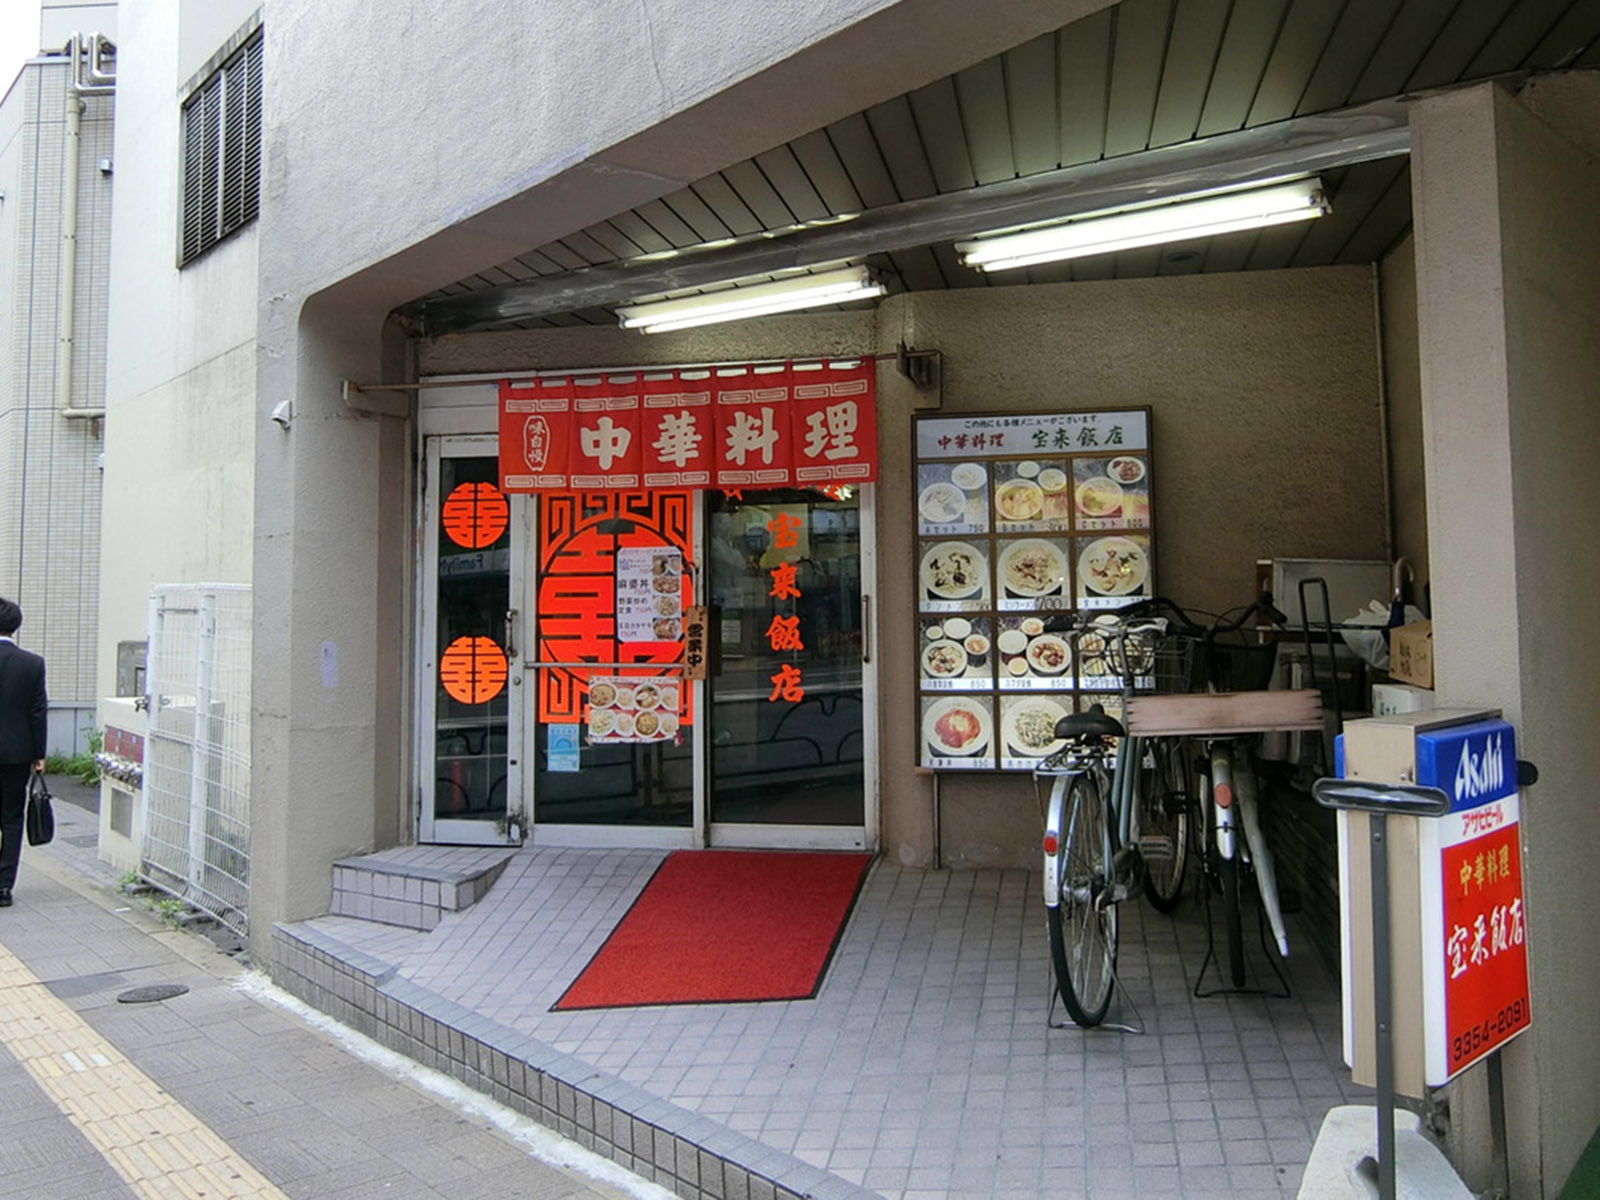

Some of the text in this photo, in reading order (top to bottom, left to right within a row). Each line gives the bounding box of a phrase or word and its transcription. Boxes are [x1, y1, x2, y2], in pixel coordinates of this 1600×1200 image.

[579, 399, 859, 470] 中華料理
[937, 426, 1124, 450] 中華料理 宝来飯店
[765, 512, 804, 703] 宝来飯店
[1038, 597, 1062, 610] 700
[1455, 731, 1504, 801] Asahi
[1462, 808, 1504, 836] アサヒビール
[1459, 843, 1510, 896] 中華料理
[1447, 897, 1524, 979] 宝来飯店
[1453, 999, 1527, 1061] 3354-2091
